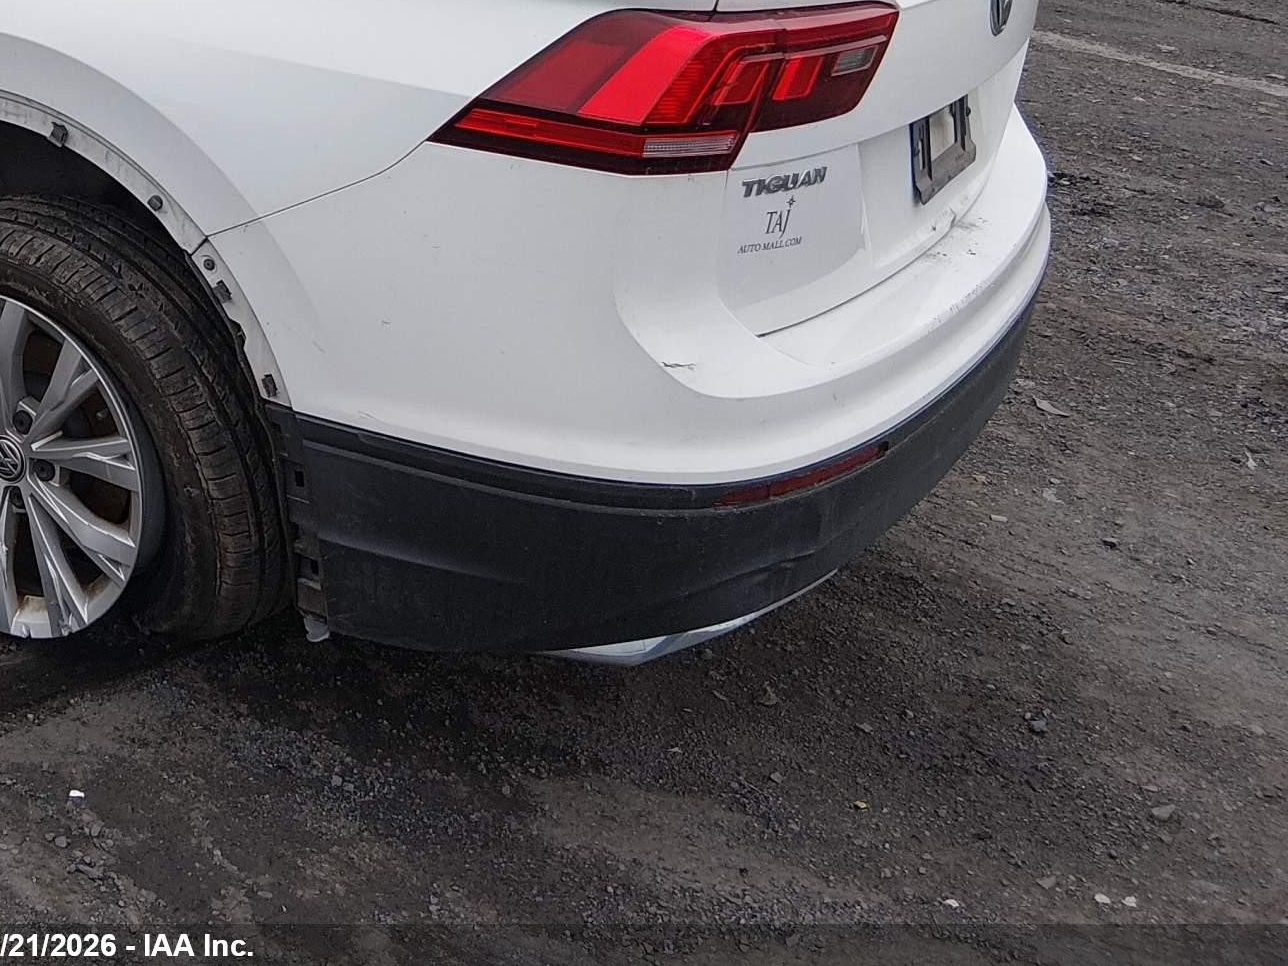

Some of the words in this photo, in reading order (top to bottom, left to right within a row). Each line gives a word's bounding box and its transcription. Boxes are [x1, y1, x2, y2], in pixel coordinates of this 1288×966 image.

[742, 166, 828, 198] TIGUAN
[765, 207, 791, 240] TAJ
[737, 243, 762, 255] AUTO
